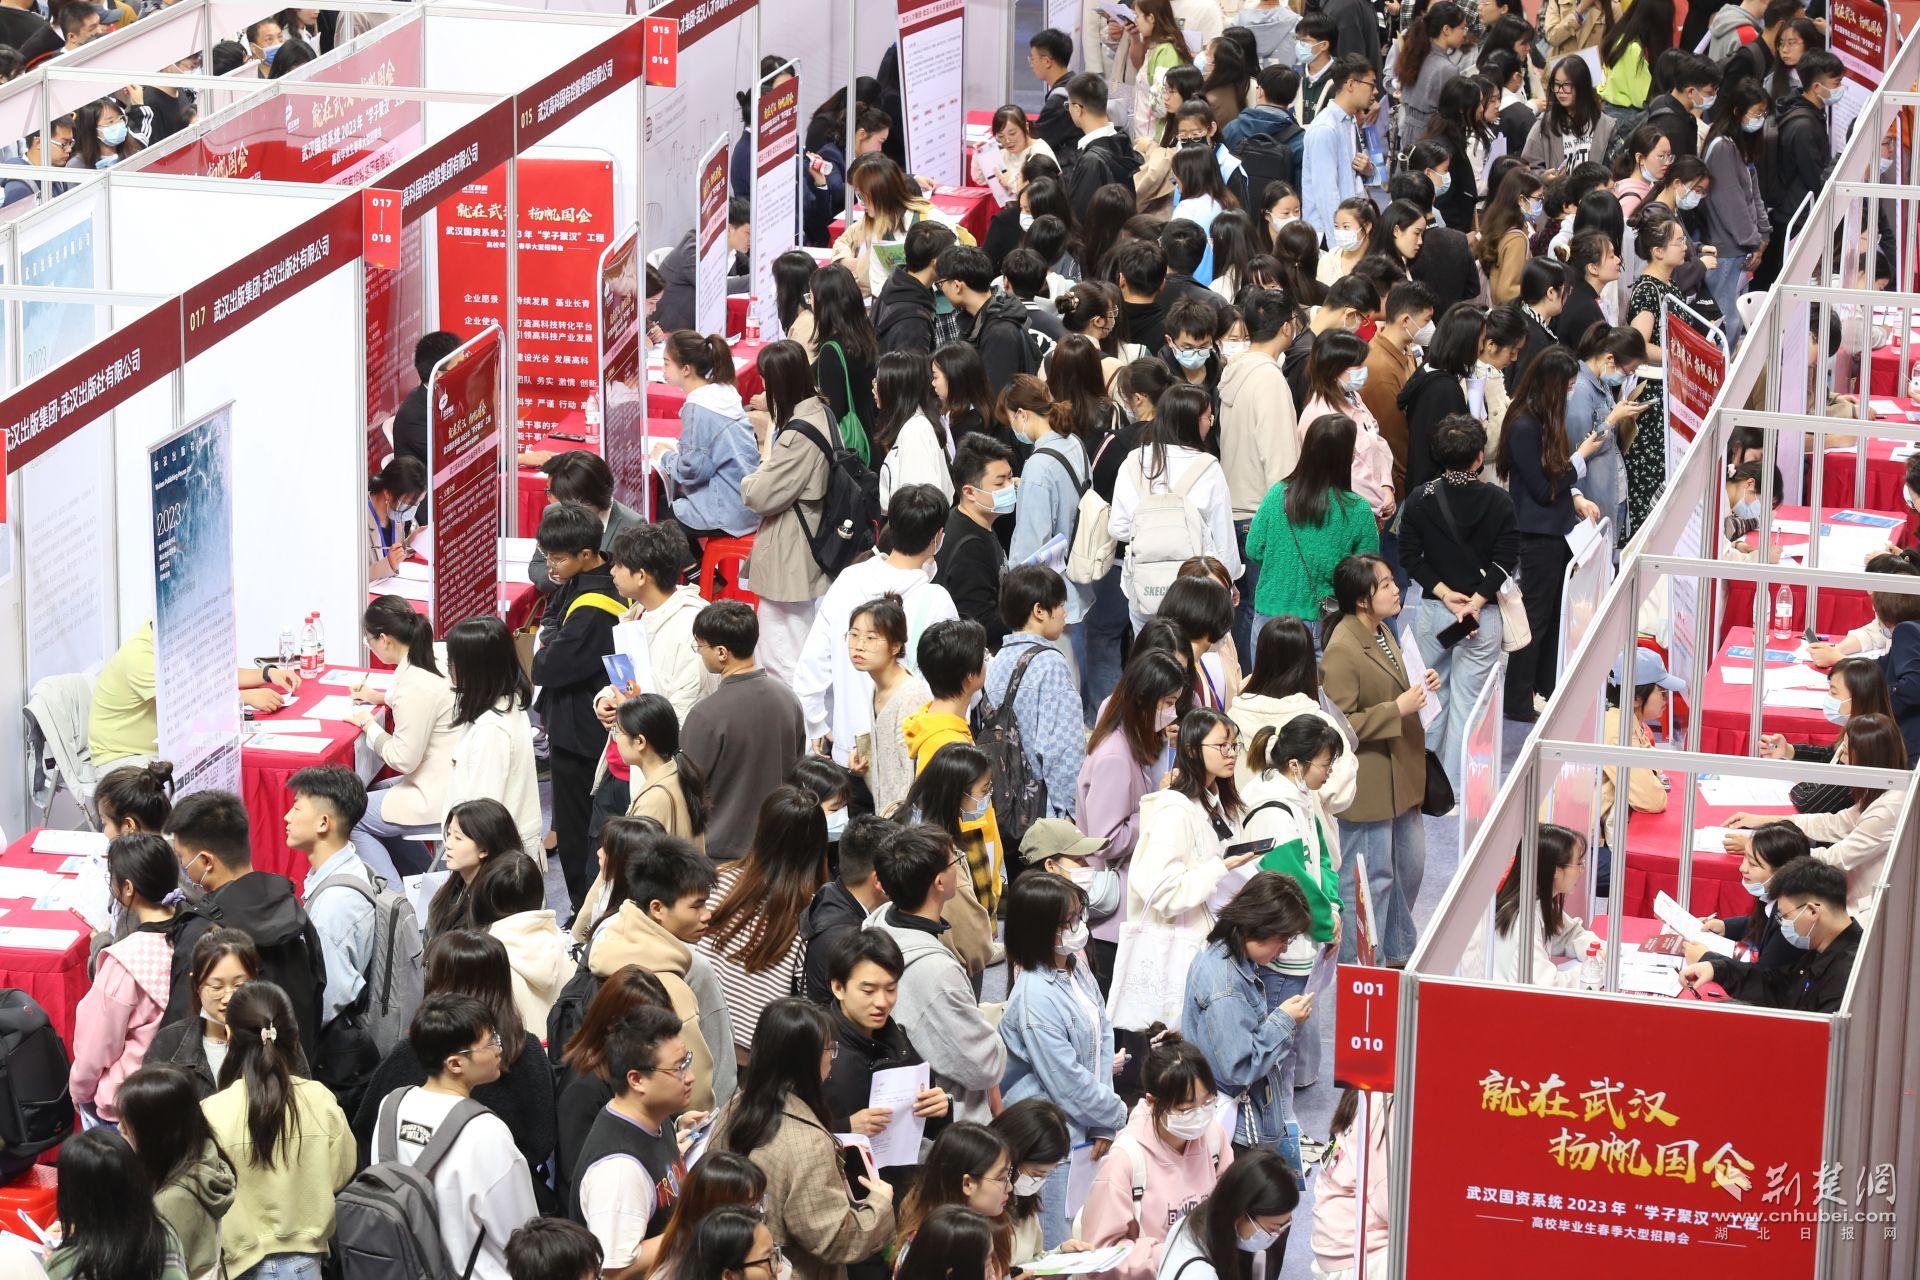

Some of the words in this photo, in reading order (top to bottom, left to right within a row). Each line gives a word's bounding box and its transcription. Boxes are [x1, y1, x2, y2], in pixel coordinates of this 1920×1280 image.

[652, 25, 670, 34] 015
[651, 56, 669, 64] 016
[521, 108, 533, 128] 015
[537, 59, 613, 124] 武汉高科国有控股集团有限公司
[372, 198, 392, 208] 017
[371, 234, 392, 244] 018
[190, 306, 206, 331] 017
[213, 234, 330, 324] 武汉出版集团·武汉出版社有限公司
[464, 294, 499, 304] 企业愿景
[555, 298, 590, 308] 基业长青
[554, 355, 589, 365] 发展高科
[537, 376, 554, 385] 务实
[558, 377, 576, 387] 激情
[537, 399, 555, 408] 严谨
[559, 400, 577, 409] 行动
[157, 502, 181, 536] 2023
[1353, 981, 1384, 996] 001
[1351, 1036, 1383, 1052] 010
[1478, 1068, 1680, 1131] 就在武汉
[1548, 1125, 1756, 1190] 扬帆国企
[1531, 1216, 1691, 1246] 高校毕业生春季大型招聘会
